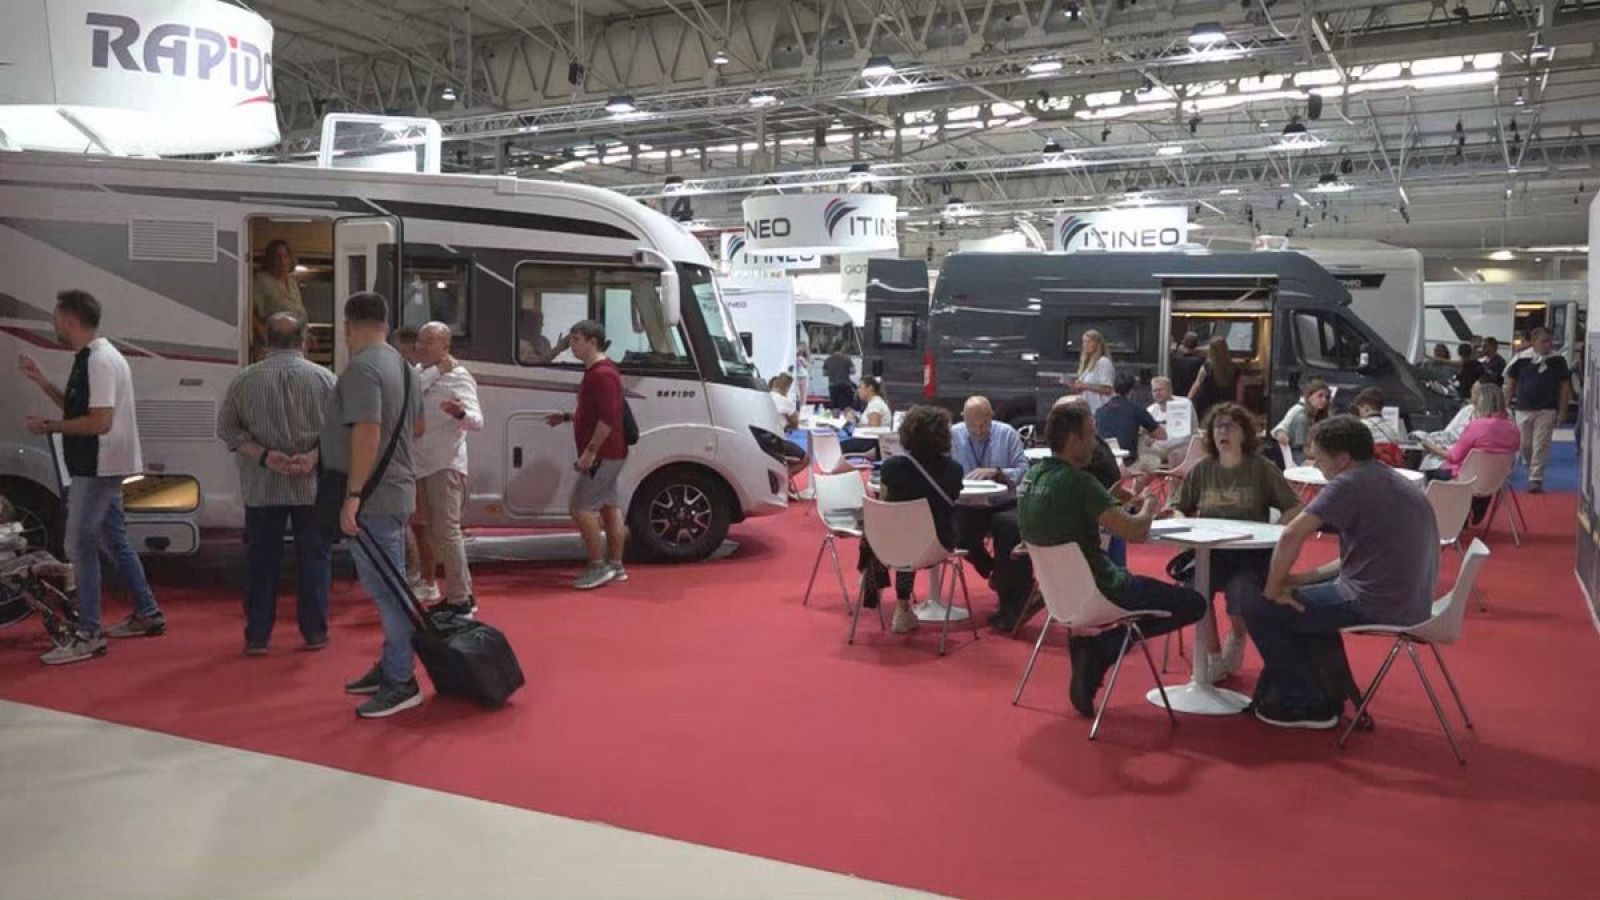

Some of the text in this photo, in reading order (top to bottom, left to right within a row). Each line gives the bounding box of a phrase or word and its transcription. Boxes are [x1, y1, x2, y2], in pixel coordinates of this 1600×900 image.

[671, 196, 693, 221] 4
[746, 217, 791, 239] NEO
[1084, 227, 1180, 248] ITINEO
[656, 390, 696, 399] RAPIDO
